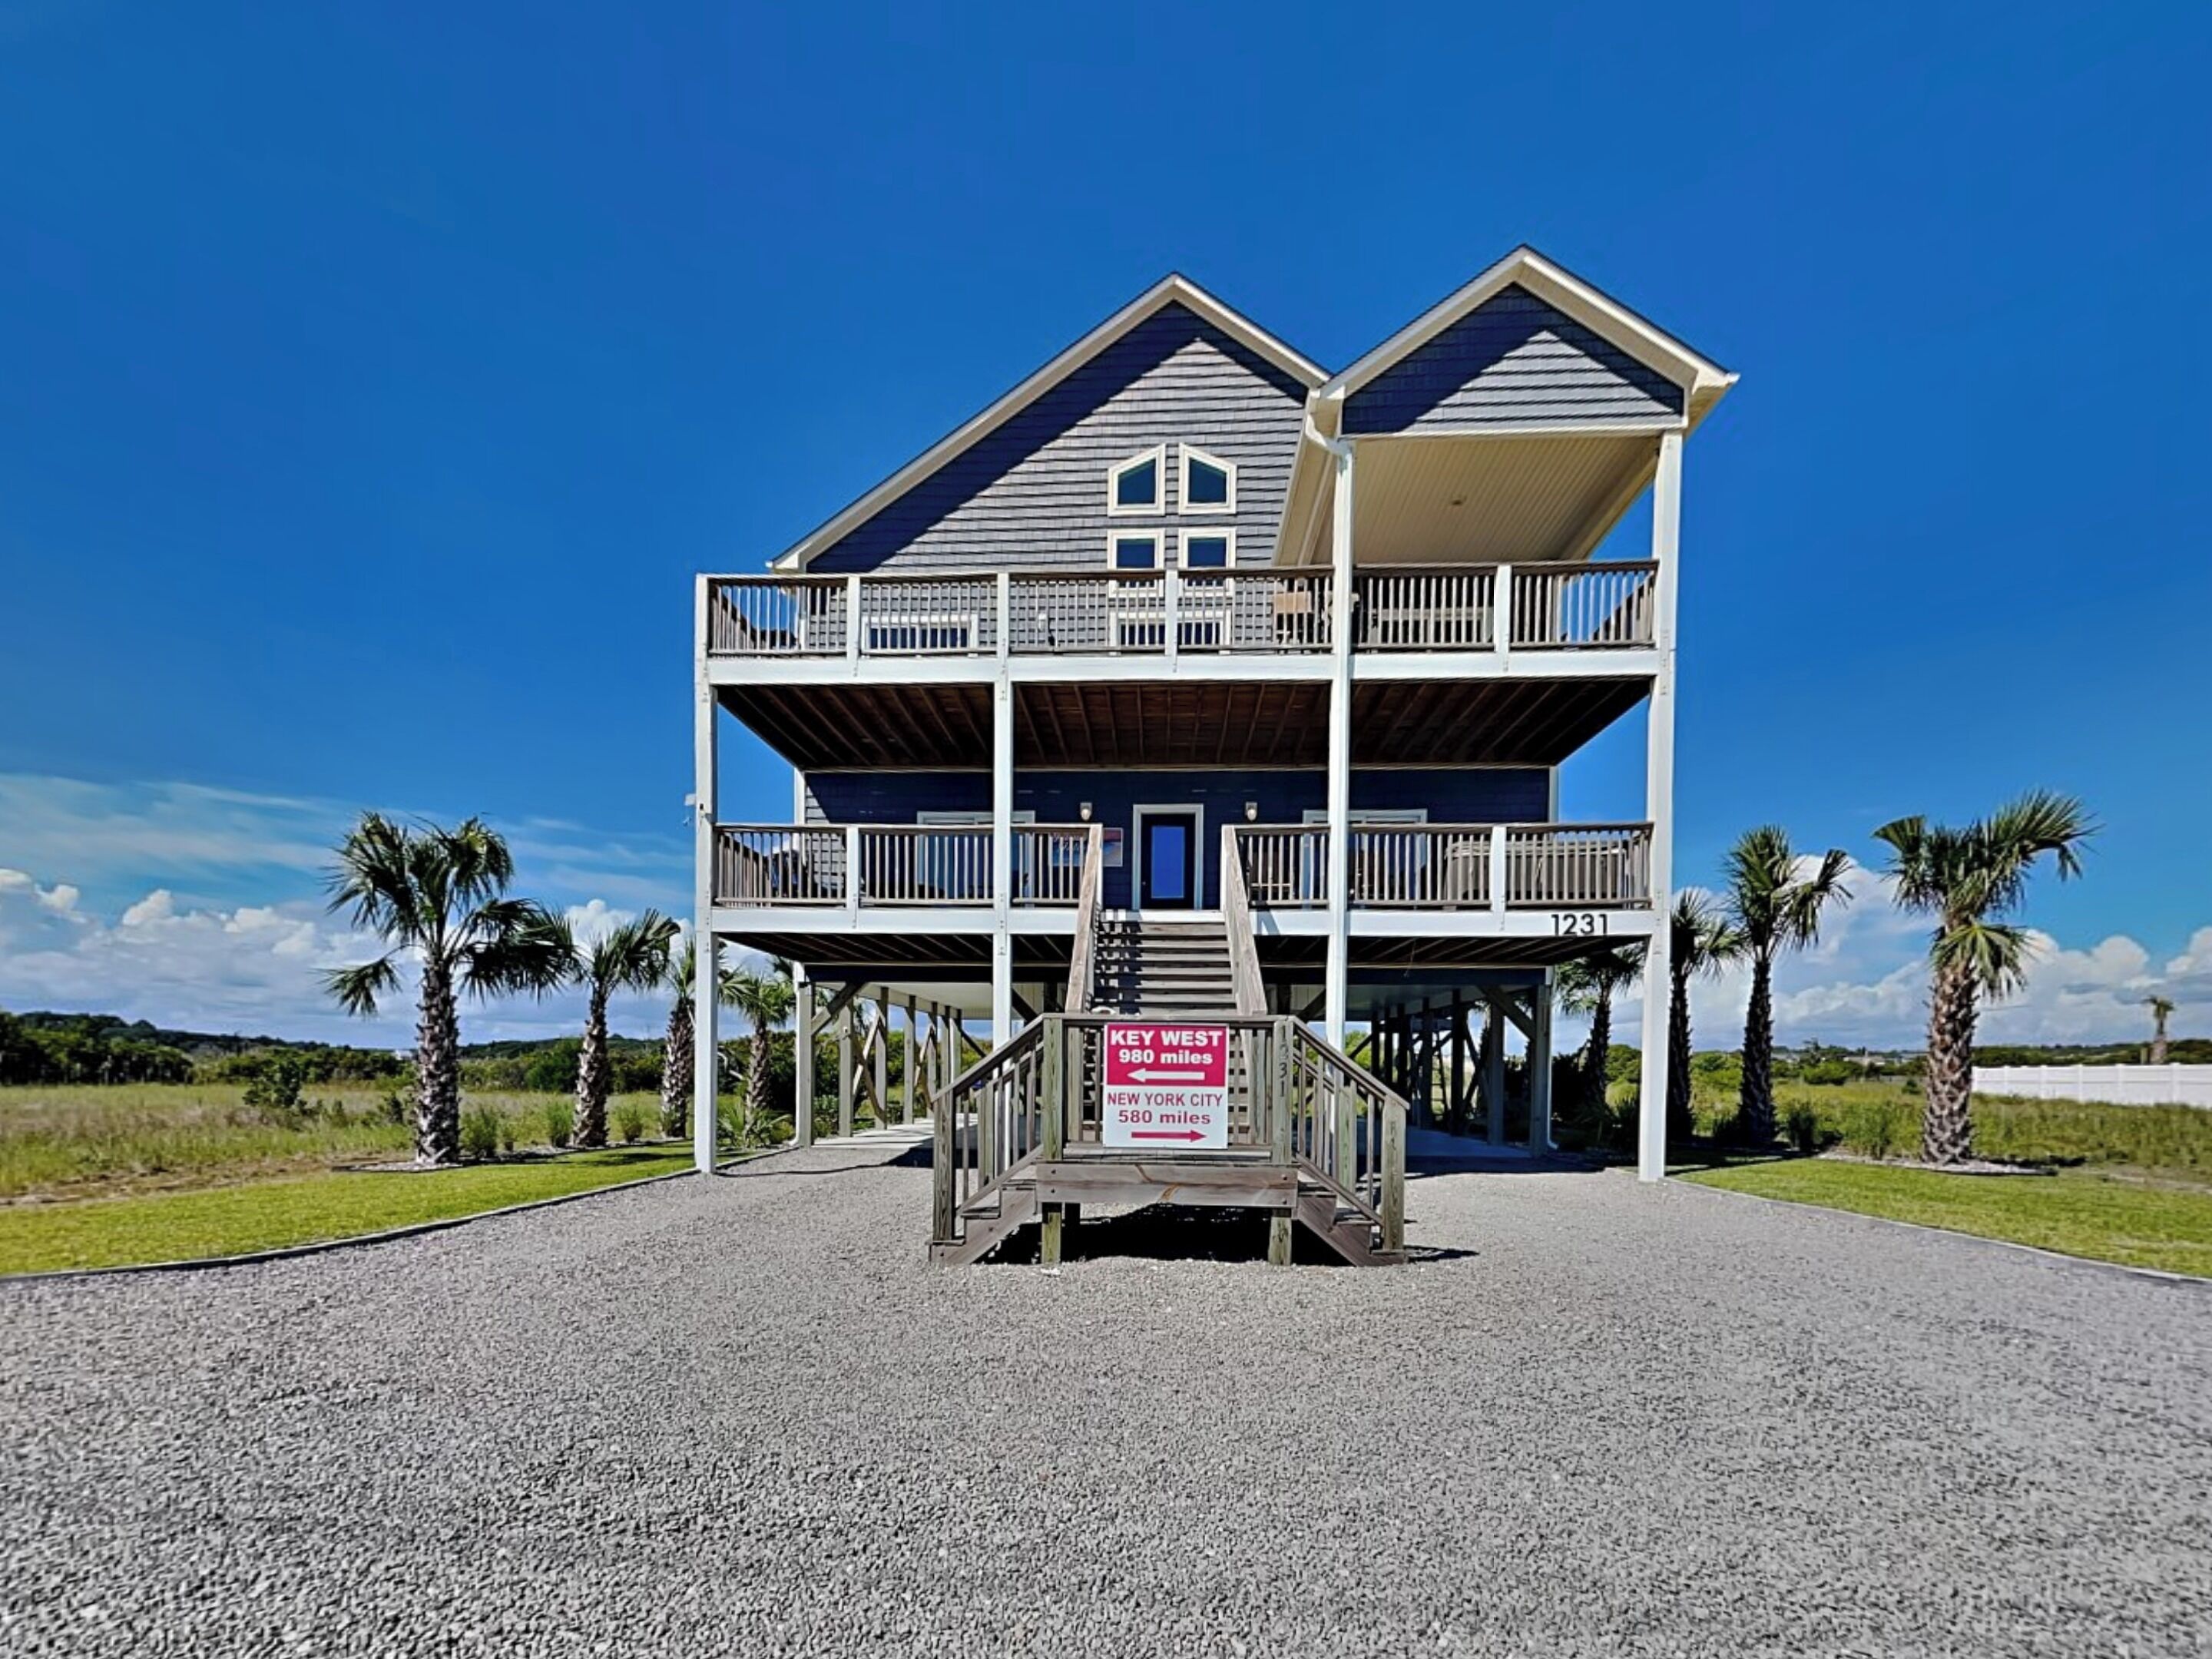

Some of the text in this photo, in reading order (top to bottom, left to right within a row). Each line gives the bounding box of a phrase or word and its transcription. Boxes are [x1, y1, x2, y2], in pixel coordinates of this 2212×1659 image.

[1551, 913, 1608, 936] 1231
[1111, 1030, 1223, 1046] KEY WEST
[1119, 1049, 1213, 1065] 980 miles
[1108, 1093, 1223, 1107] NEW YORK CITY
[1118, 1110, 1211, 1124] 580 miles
